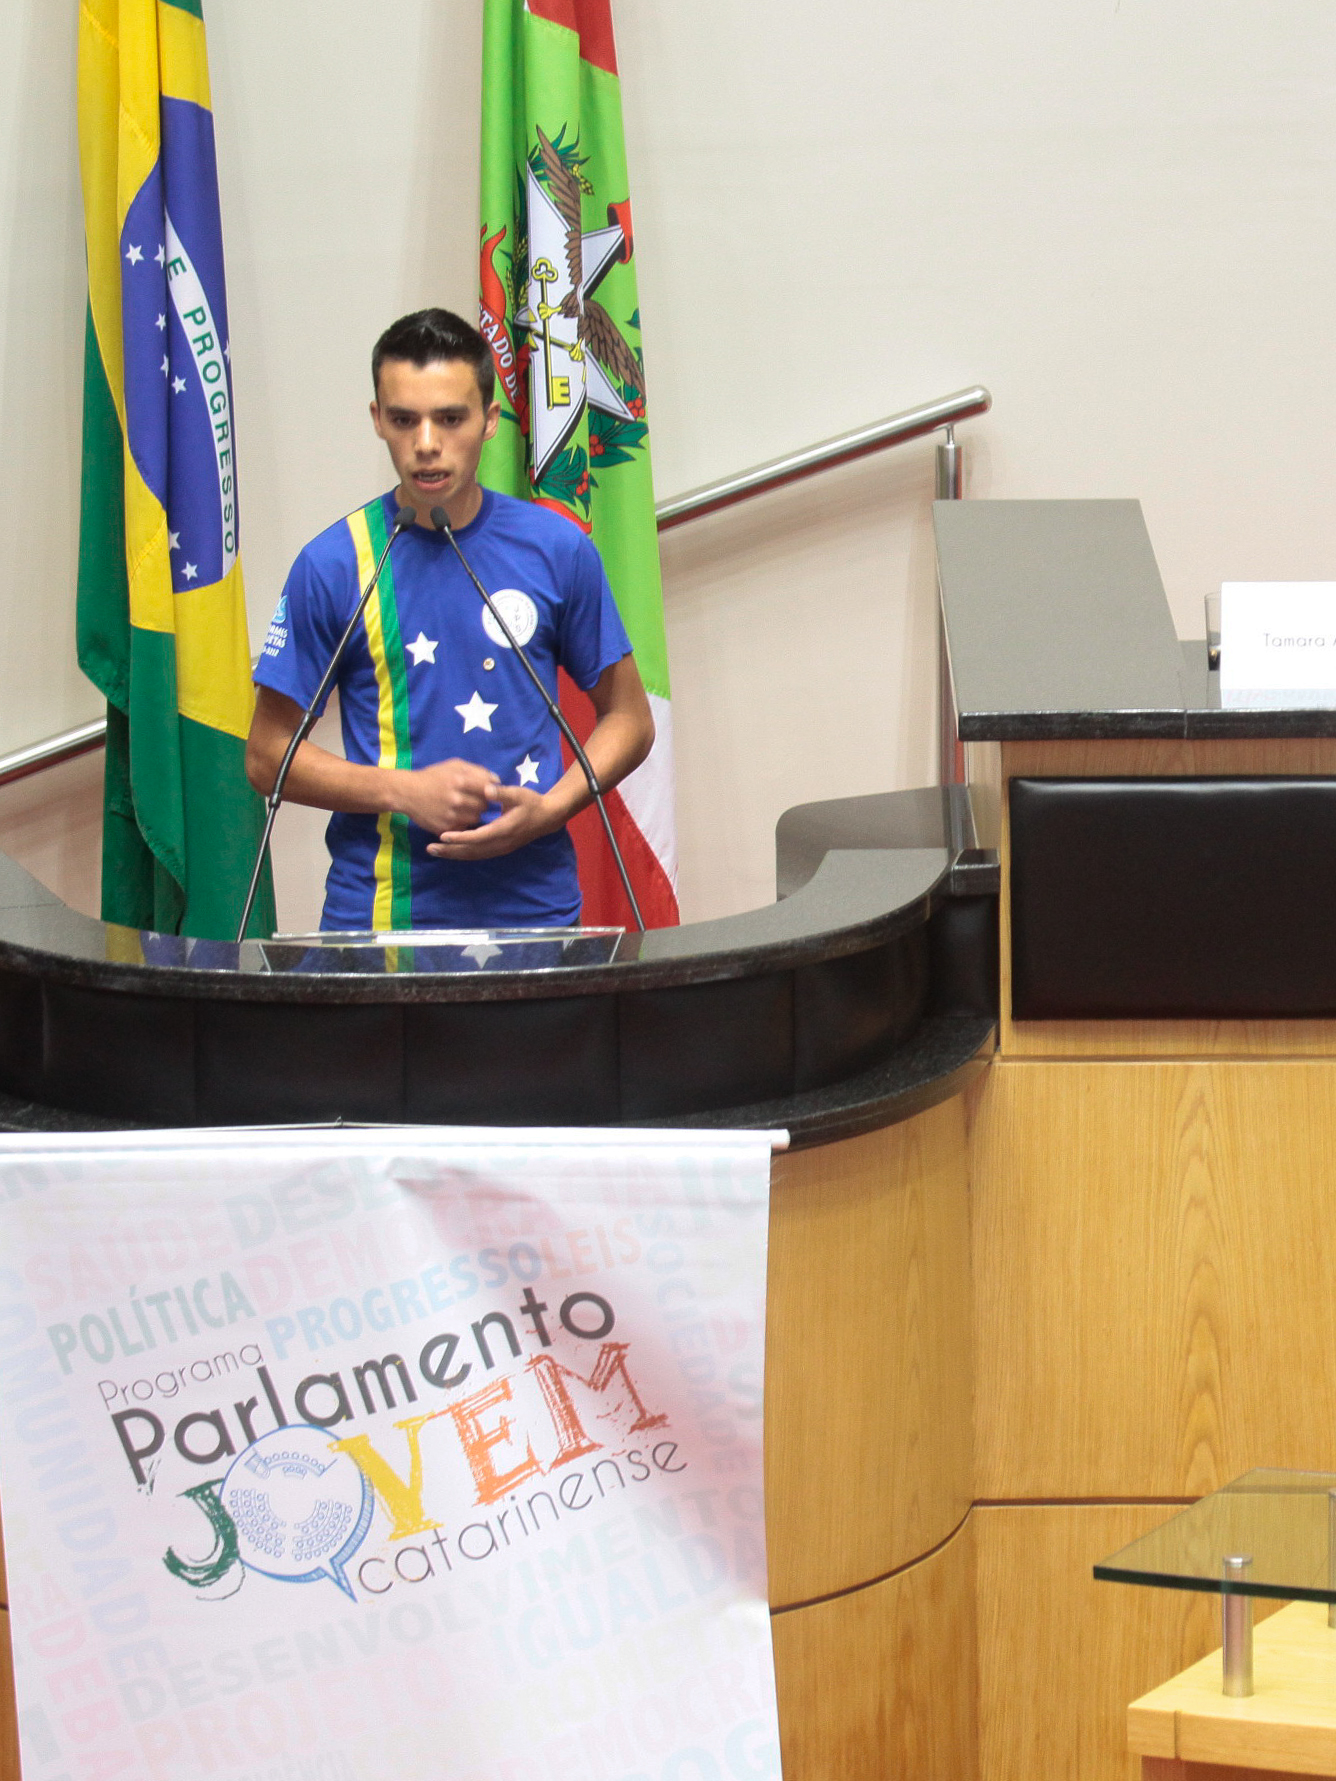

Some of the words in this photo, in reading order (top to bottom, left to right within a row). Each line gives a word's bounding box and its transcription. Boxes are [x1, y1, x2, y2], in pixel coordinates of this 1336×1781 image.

[479, 303, 513, 369] TADO
[167, 255, 188, 283] E
[182, 305, 235, 556] PROGRESSO
[1263, 632, 1326, 648] Tamara
[46, 1270, 257, 1377] POLÍTICA
[263, 1241, 543, 1362] PROGRESSO
[538, 1217, 642, 1282] LEIS
[97, 1343, 265, 1411] Programa
[111, 1286, 616, 1487] Parlamento
[357, 1439, 689, 1595] catarinense
